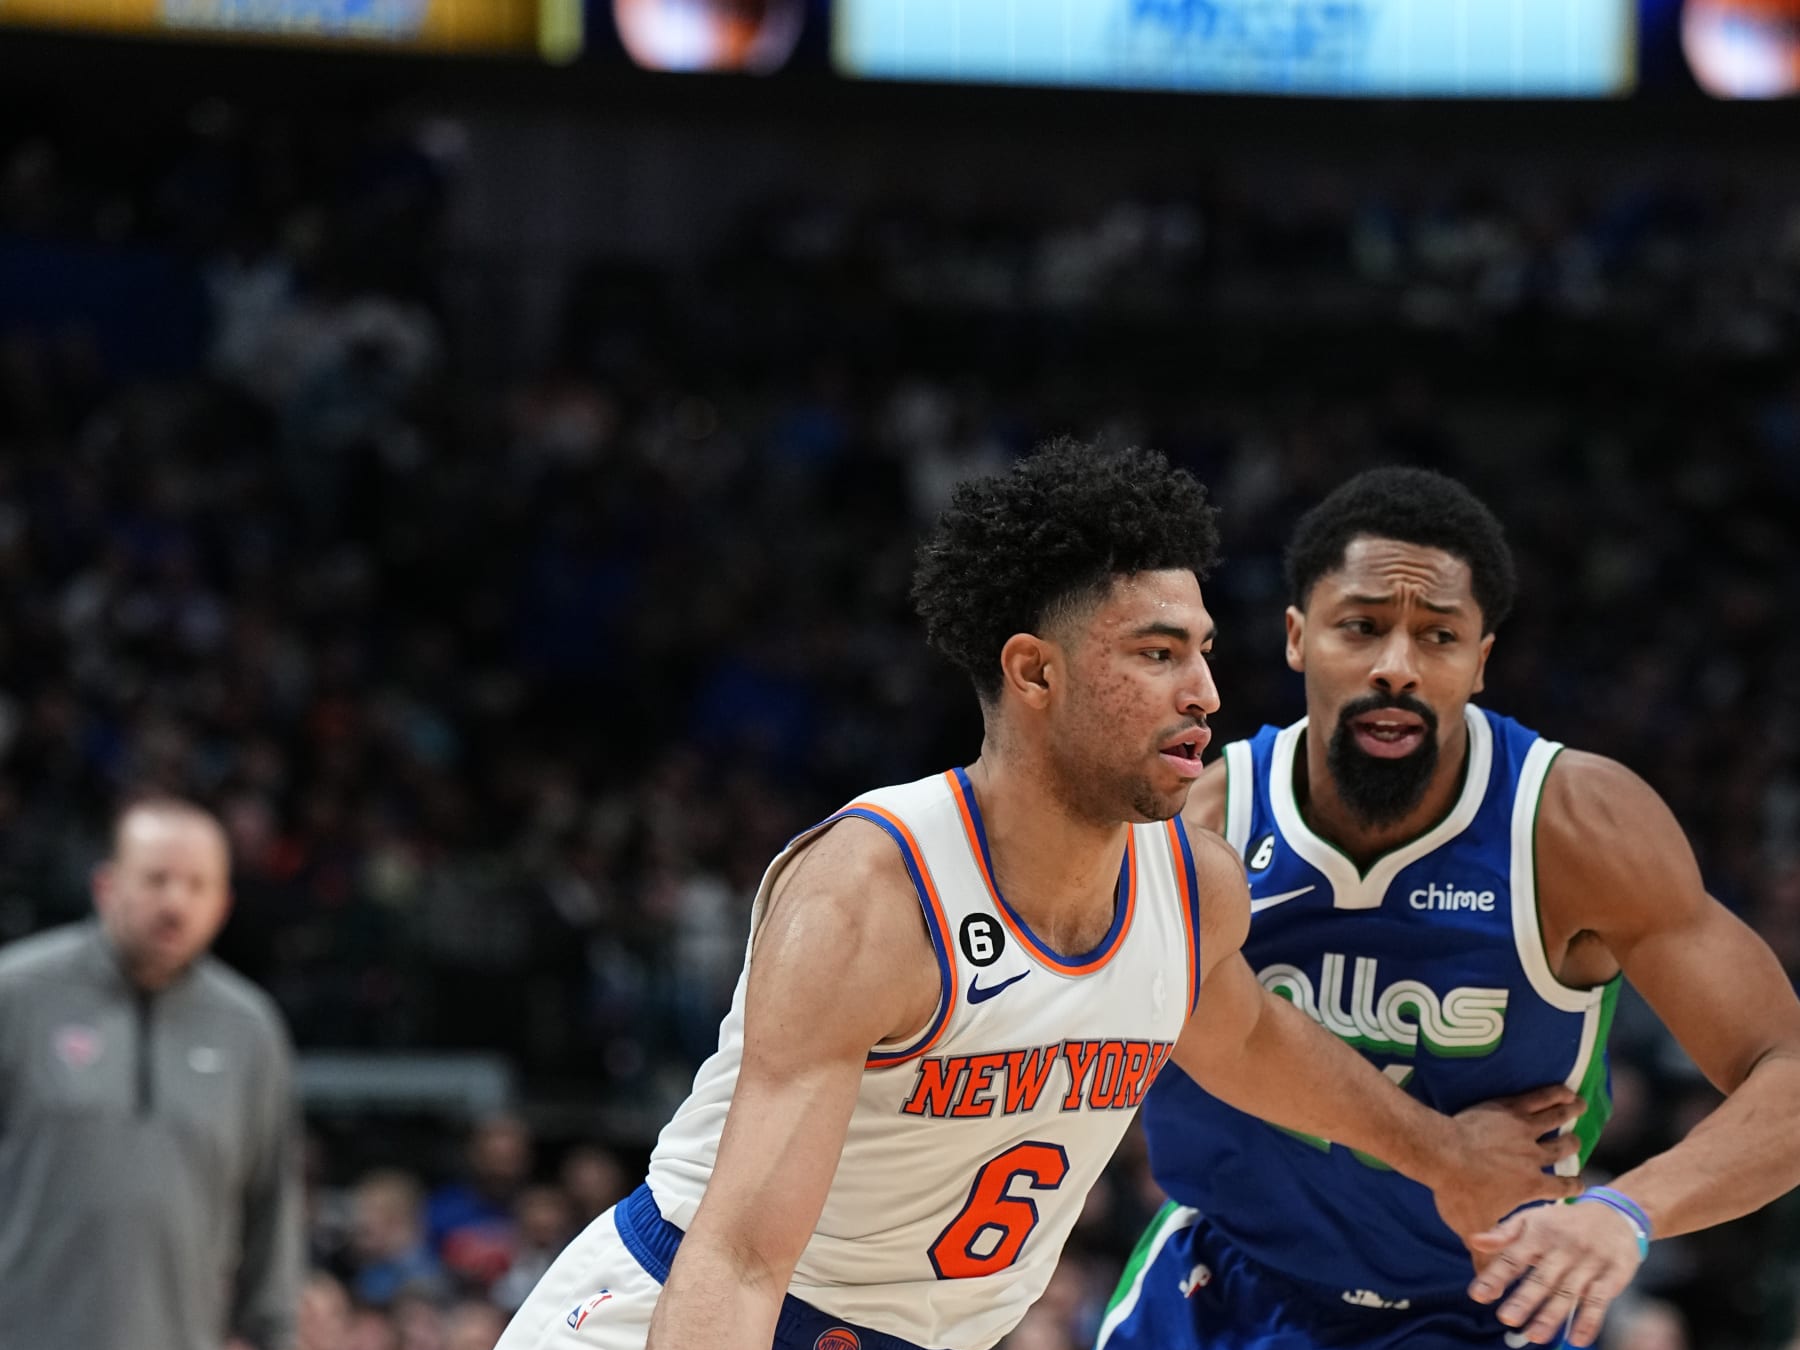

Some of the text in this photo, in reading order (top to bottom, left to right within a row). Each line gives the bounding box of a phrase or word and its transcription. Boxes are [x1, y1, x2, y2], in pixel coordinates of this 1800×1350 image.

[1250, 834, 1275, 870] 6
[1408, 882, 1496, 912] chime
[967, 920, 994, 961] 6
[1256, 952, 1510, 1056] allas
[900, 1043, 1060, 1119] NEW
[926, 1140, 1070, 1281] 6
